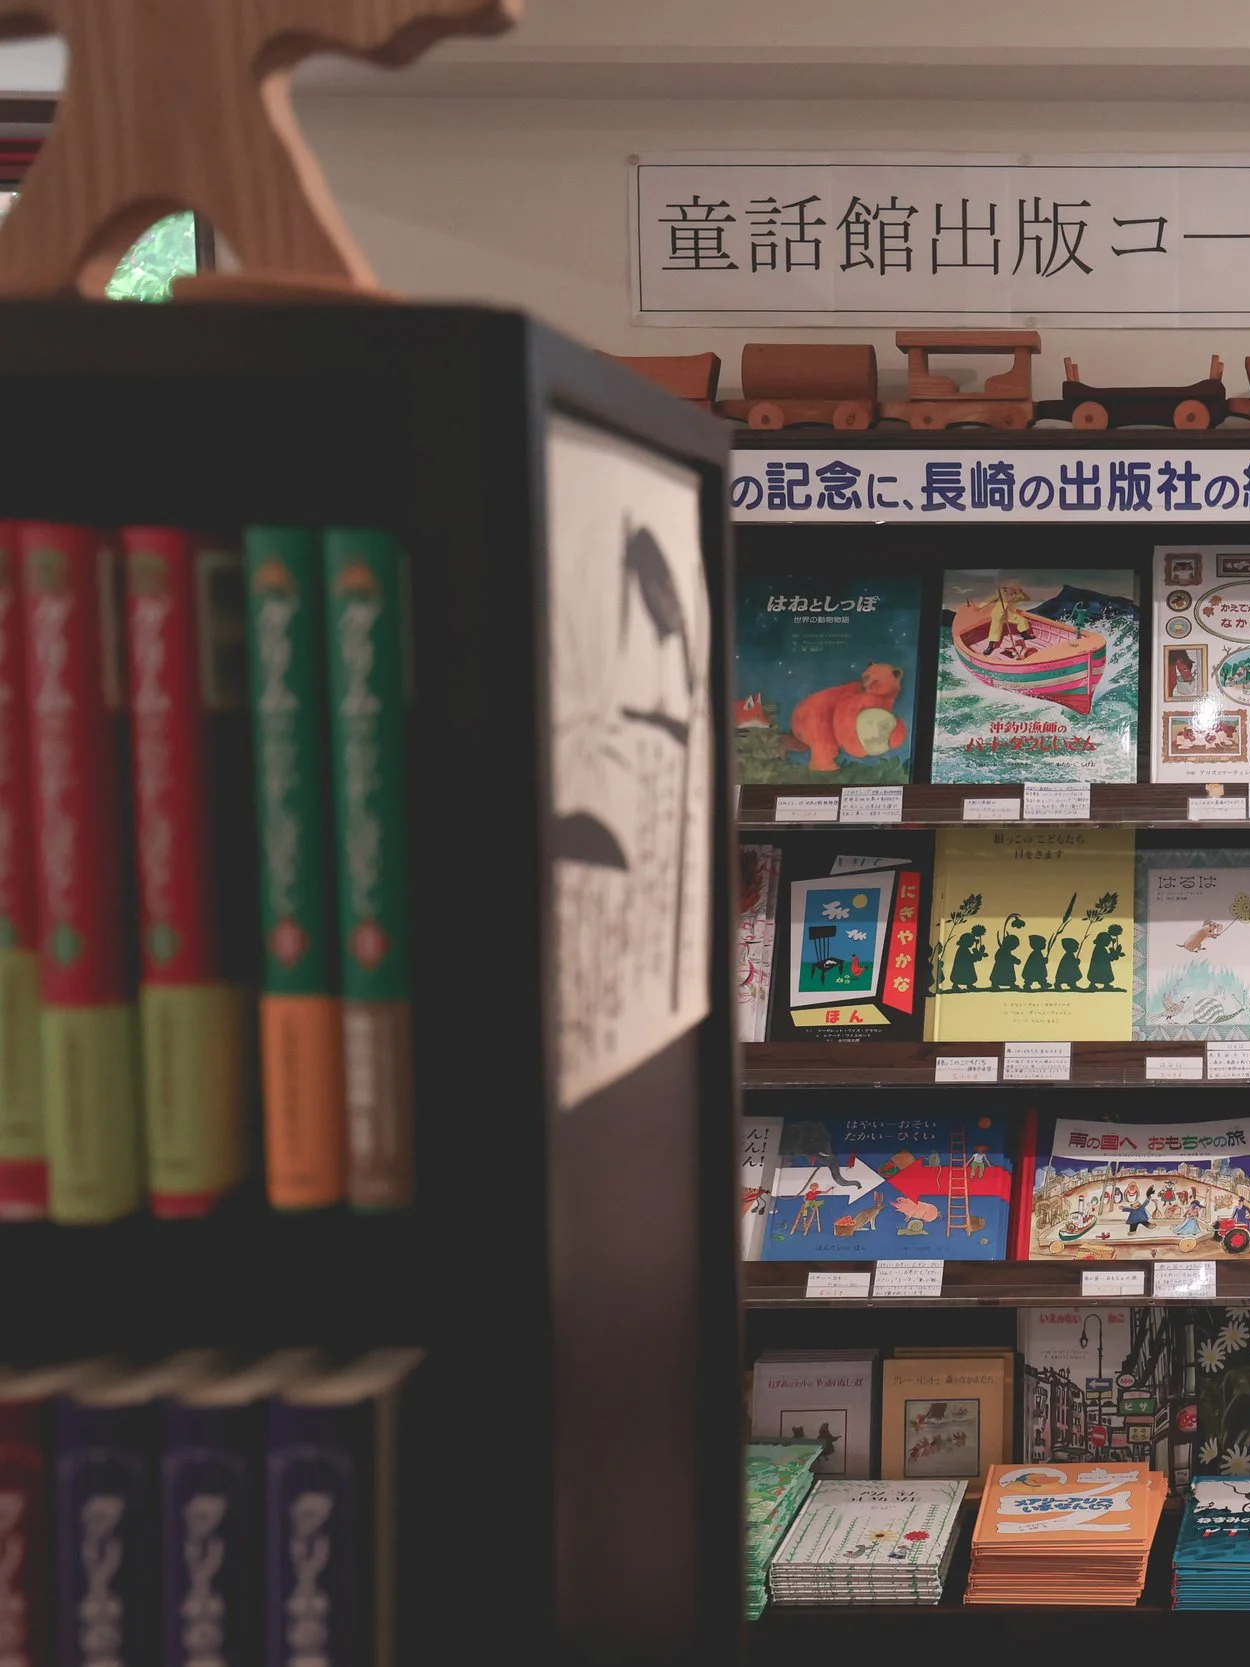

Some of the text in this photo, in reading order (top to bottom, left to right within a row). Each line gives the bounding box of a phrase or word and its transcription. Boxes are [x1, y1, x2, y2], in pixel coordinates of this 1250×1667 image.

[767, 595, 880, 612] はねとしっぽ
[990, 721, 1068, 735] 沖釣り漁師の
[1158, 875, 1217, 889] はるは
[894, 884, 917, 993] にぎやかな
[825, 1010, 864, 1024] ほん
[1068, 1130, 1247, 1151] 南の国へ おもちゃの旅
